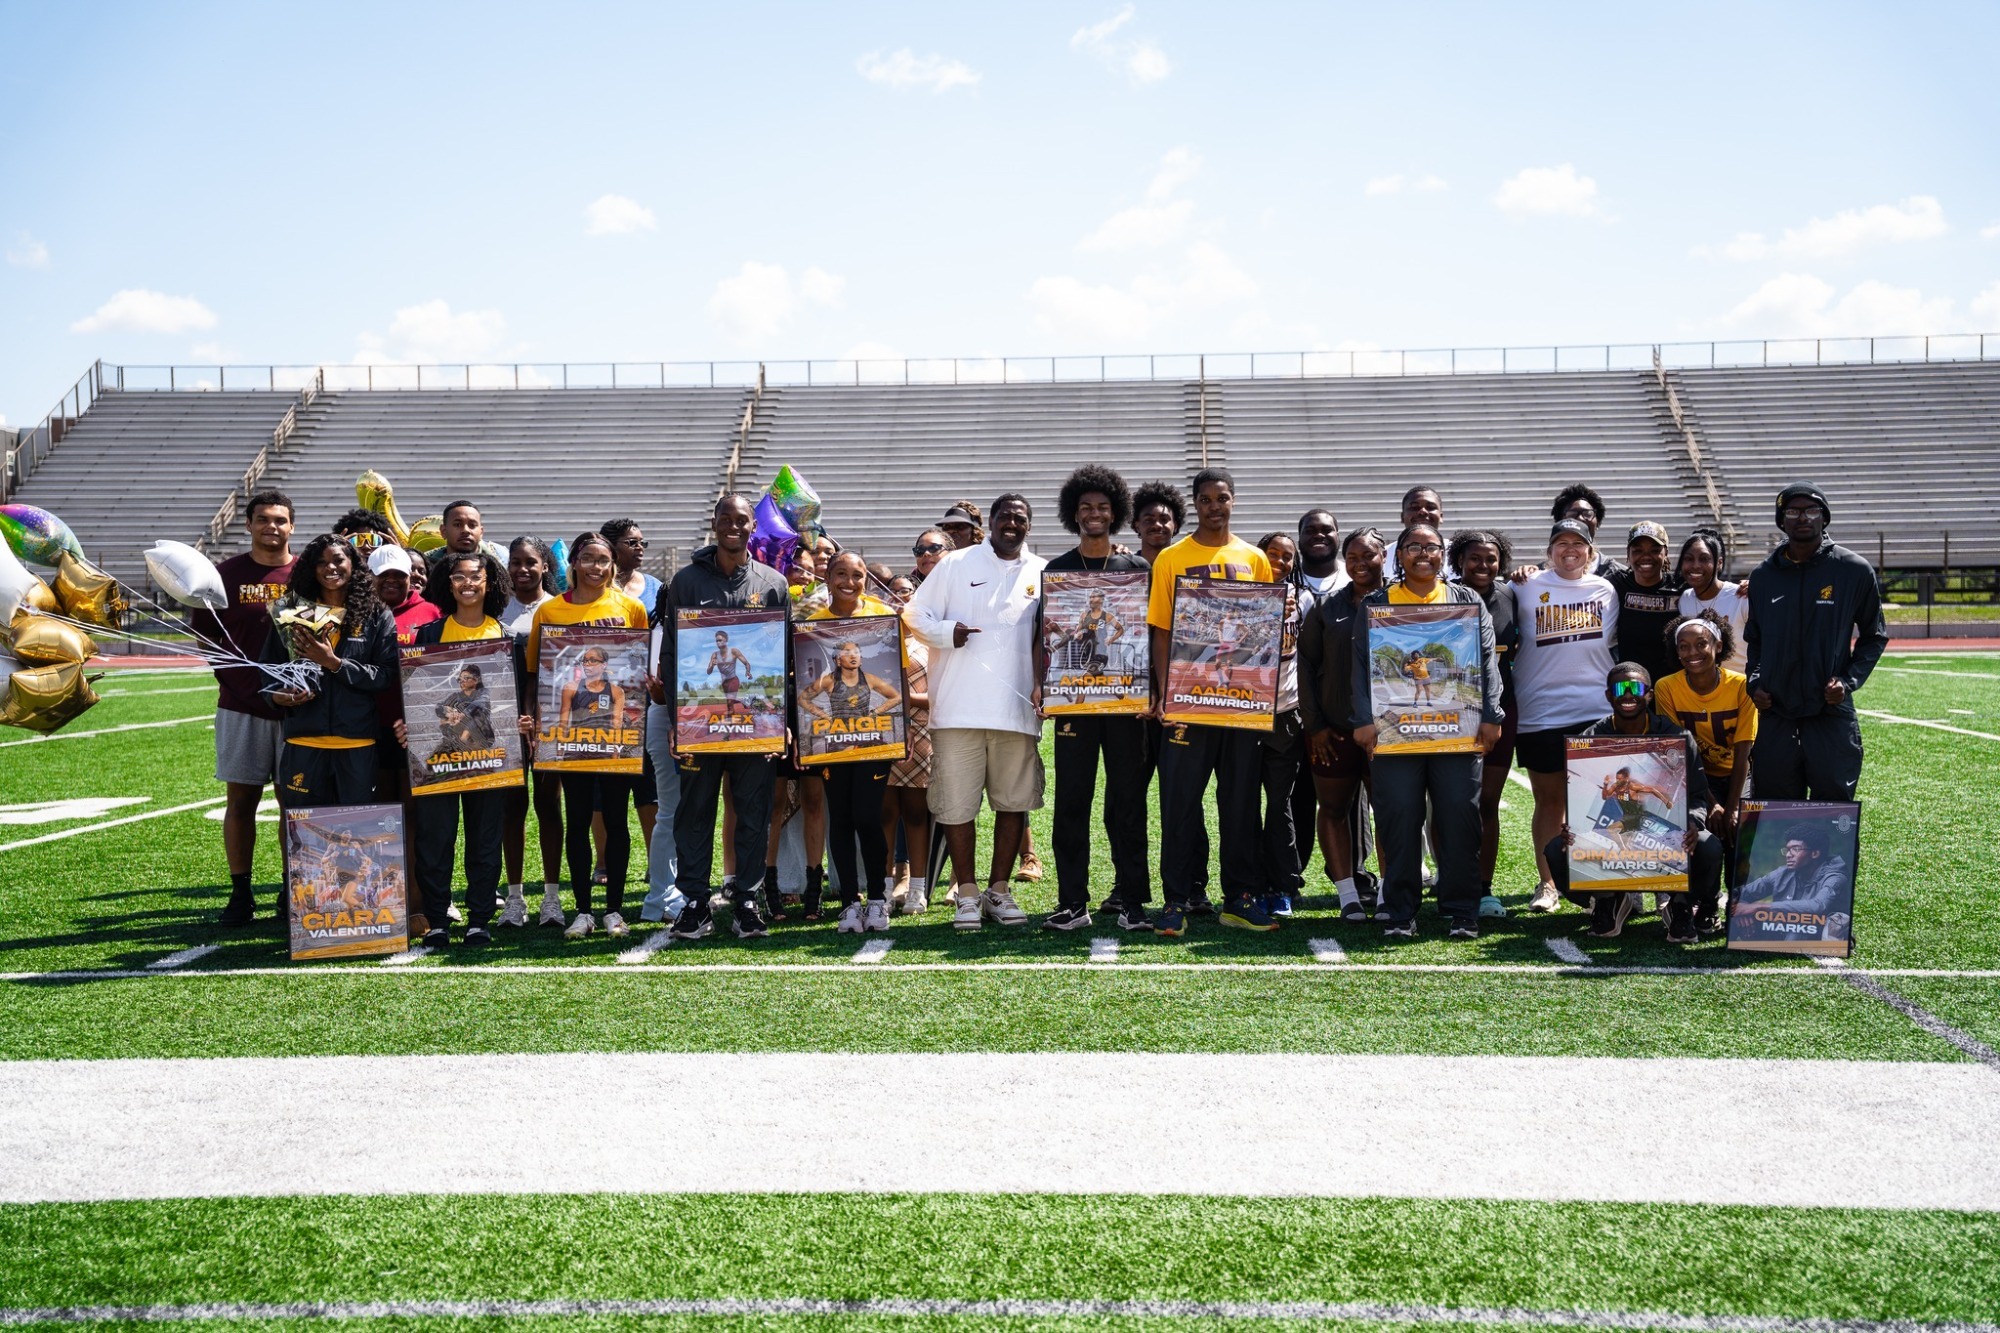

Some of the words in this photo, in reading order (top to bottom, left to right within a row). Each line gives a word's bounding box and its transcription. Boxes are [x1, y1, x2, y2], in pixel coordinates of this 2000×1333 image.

[1536, 601, 1603, 635] MARAUDERS
[1060, 676, 1133, 686] ANDREW
[1050, 686, 1143, 695] DRUMWRIGHT
[1190, 685, 1253, 700] AARON
[1173, 694, 1270, 710] DRUMWRIGHT
[708, 714, 754, 724] ALEX
[1399, 713, 1458, 723] ALEAH
[709, 725, 754, 733] PAYNE
[812, 715, 893, 735] PAIGE
[1399, 724, 1459, 733] OTABOR
[539, 727, 639, 745] JURNIE
[825, 732, 880, 743] TURNER
[557, 743, 625, 753] HEMSLEY
[426, 747, 507, 765] JASMINE
[432, 758, 503, 773] WILLIAMS
[1602, 861, 1657, 870] MARKS
[302, 908, 396, 930] CIARA
[1755, 910, 1827, 925] QIADEN
[309, 925, 391, 938] VALENTINE
[1762, 922, 1818, 934] MARKS
